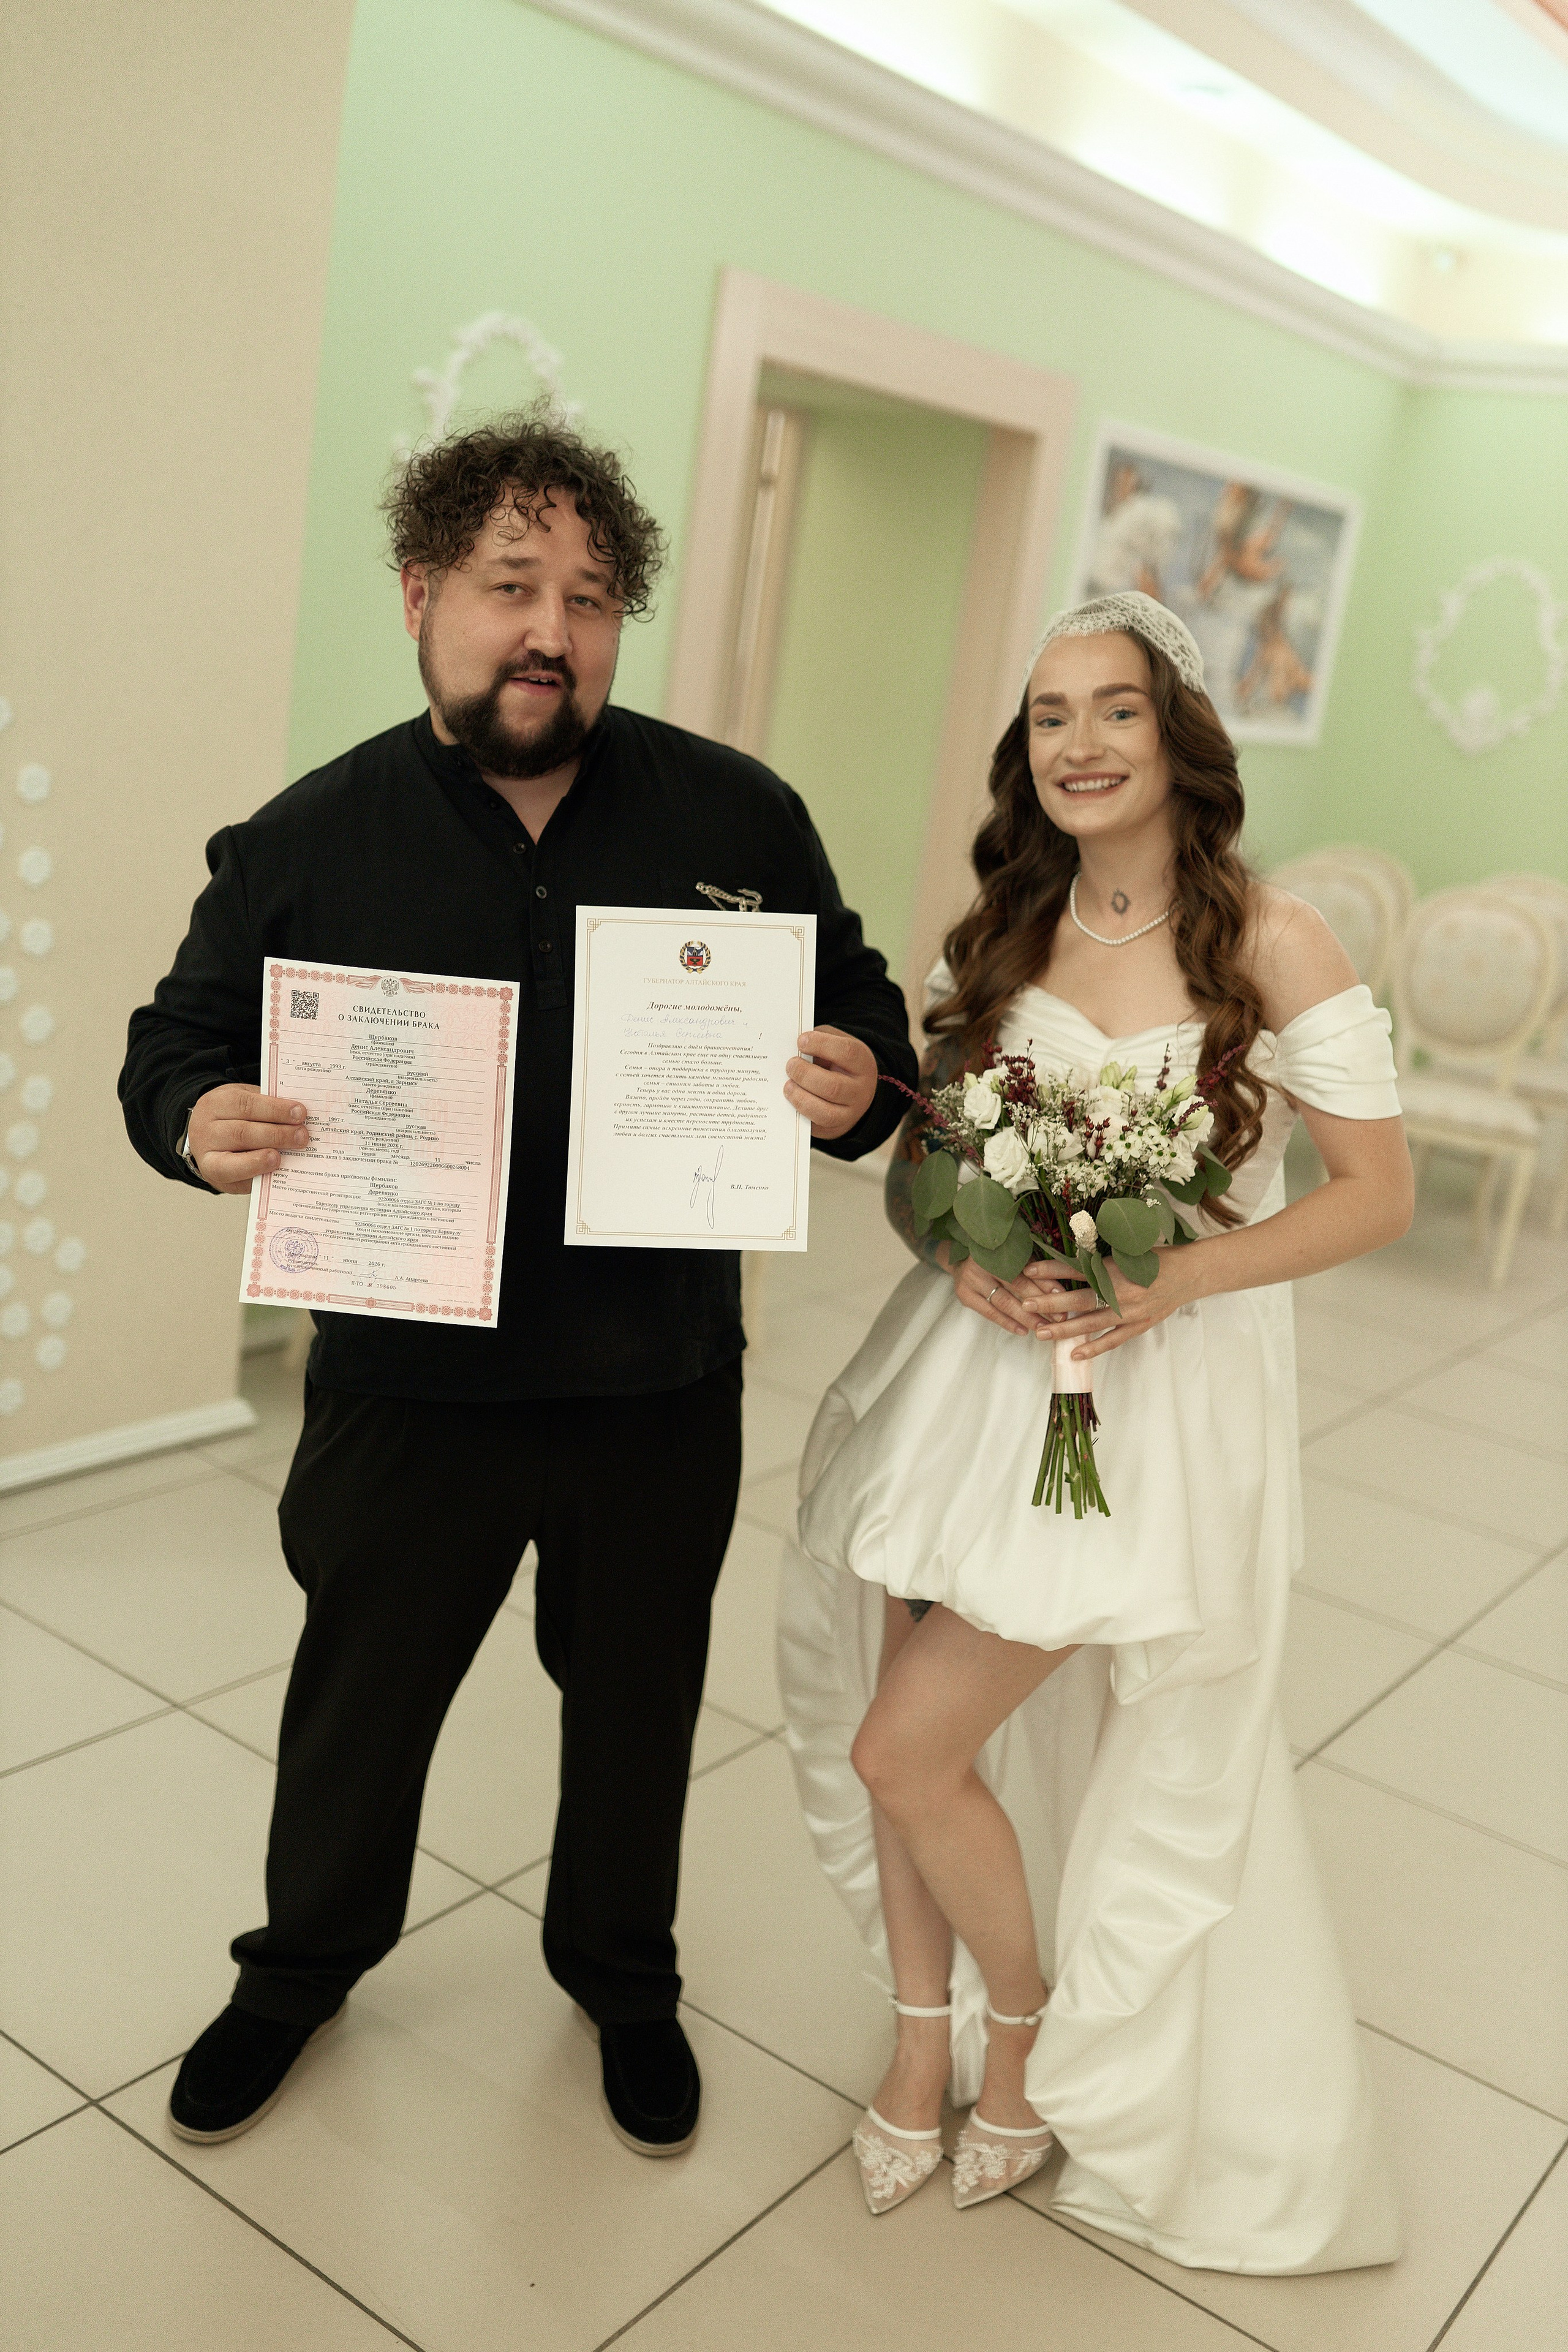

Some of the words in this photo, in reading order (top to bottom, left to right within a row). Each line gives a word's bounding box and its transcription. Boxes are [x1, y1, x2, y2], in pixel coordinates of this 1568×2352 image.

[352, 1005, 426, 1018] СВИДЕТЕЛЬСТВО
[647, 1001, 682, 1012] Дорогие
[684, 1003, 742, 1014] молодожёны,
[347, 1014, 409, 1027] ЗАКЛЮЧЕНИИ
[409, 1020, 440, 1030] БРАКА
[369, 1045, 415, 1054] Александрович
[382, 1057, 412, 1065] Федерация
[395, 1078, 418, 1087] Заринск
[366, 1087, 397, 1096] Деревянко
[351, 1107, 381, 1116] Российская
[381, 1110, 410, 1119] Федерация
[320, 1125, 350, 1134] Алтайский
